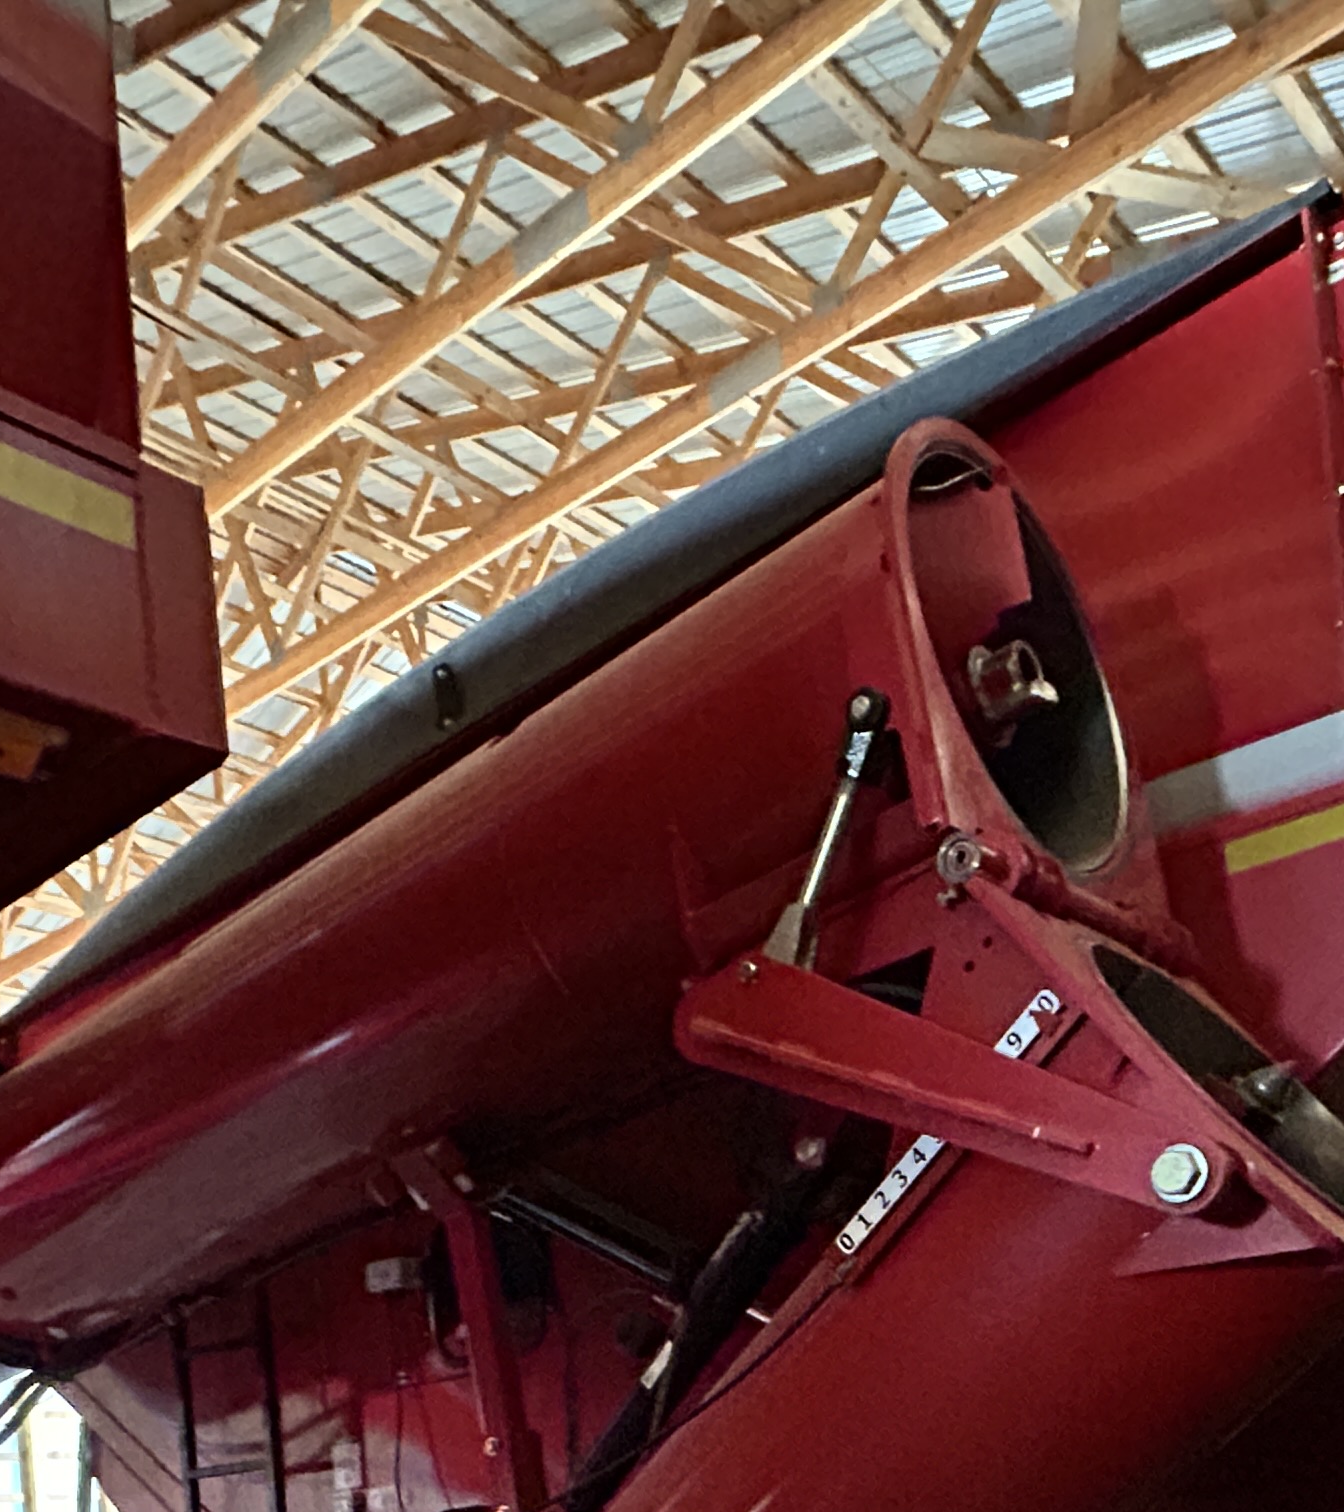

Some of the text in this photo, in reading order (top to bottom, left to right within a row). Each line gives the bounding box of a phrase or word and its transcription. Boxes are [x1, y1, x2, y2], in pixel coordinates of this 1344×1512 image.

[1006, 1032, 1022, 1051] 9
[839, 1147, 927, 1250] 0 1 2 3 4
